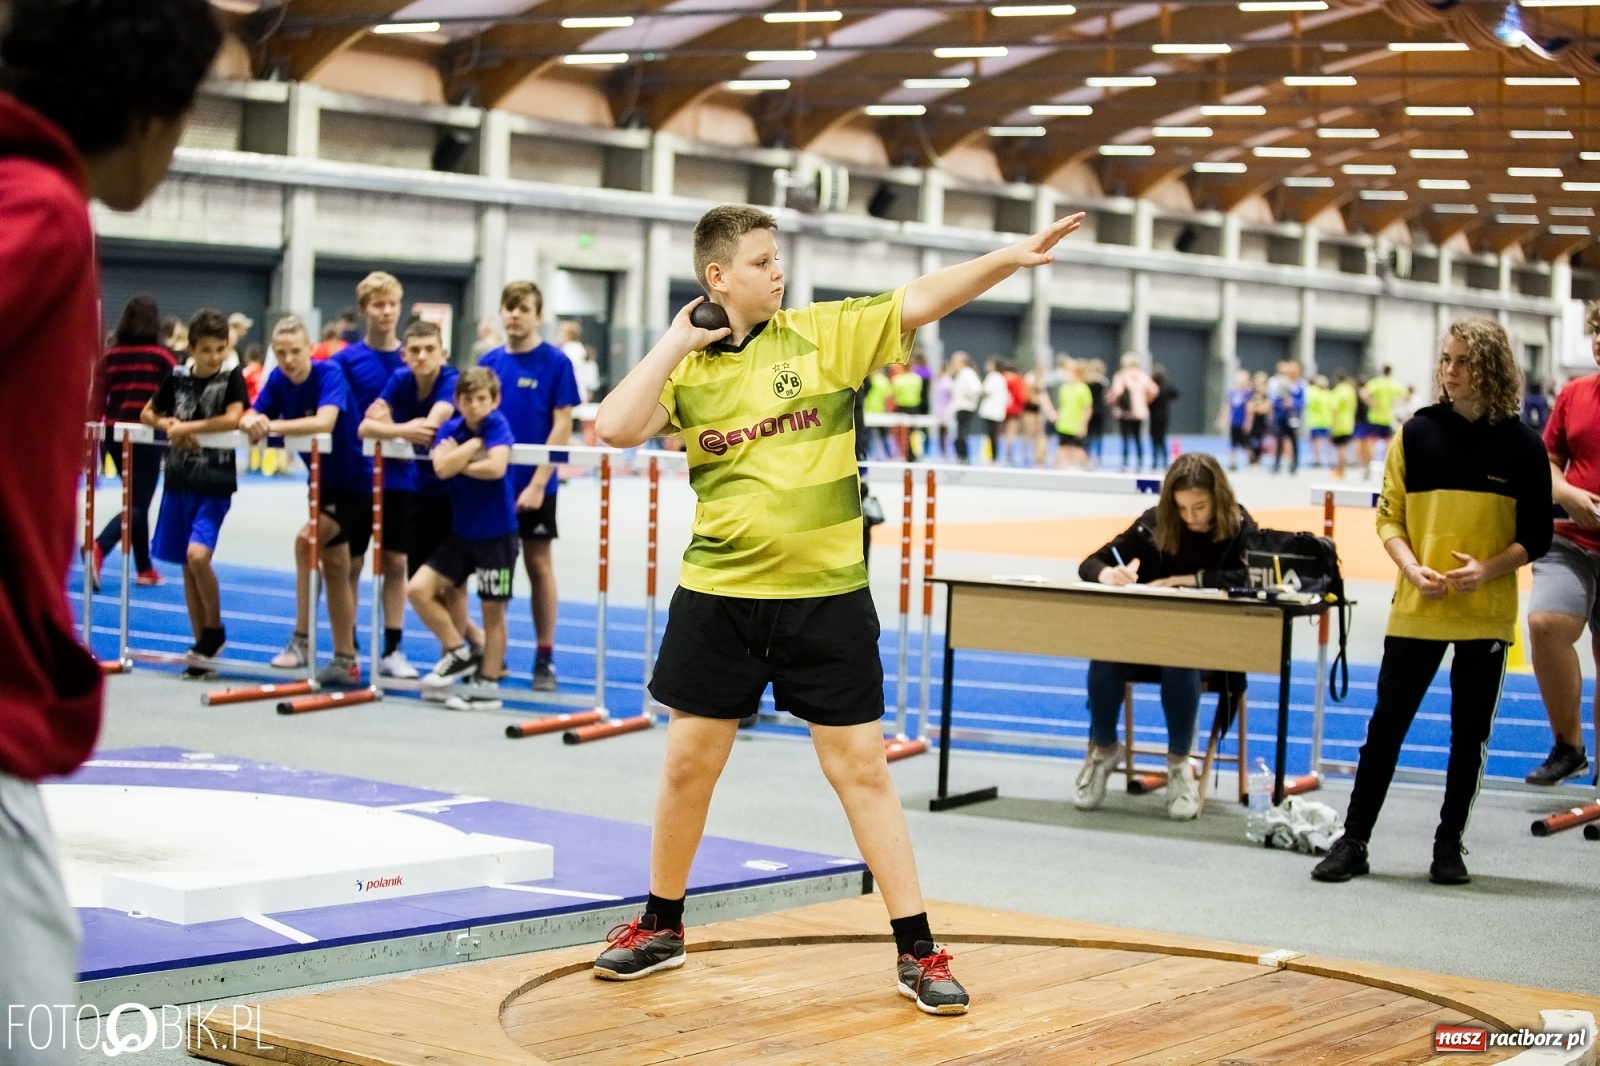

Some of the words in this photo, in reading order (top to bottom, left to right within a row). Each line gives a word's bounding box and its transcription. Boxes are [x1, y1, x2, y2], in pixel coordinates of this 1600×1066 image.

[775, 373, 800, 394] BVB
[1248, 567, 1302, 591] FILA
[365, 875, 403, 892] polanik
